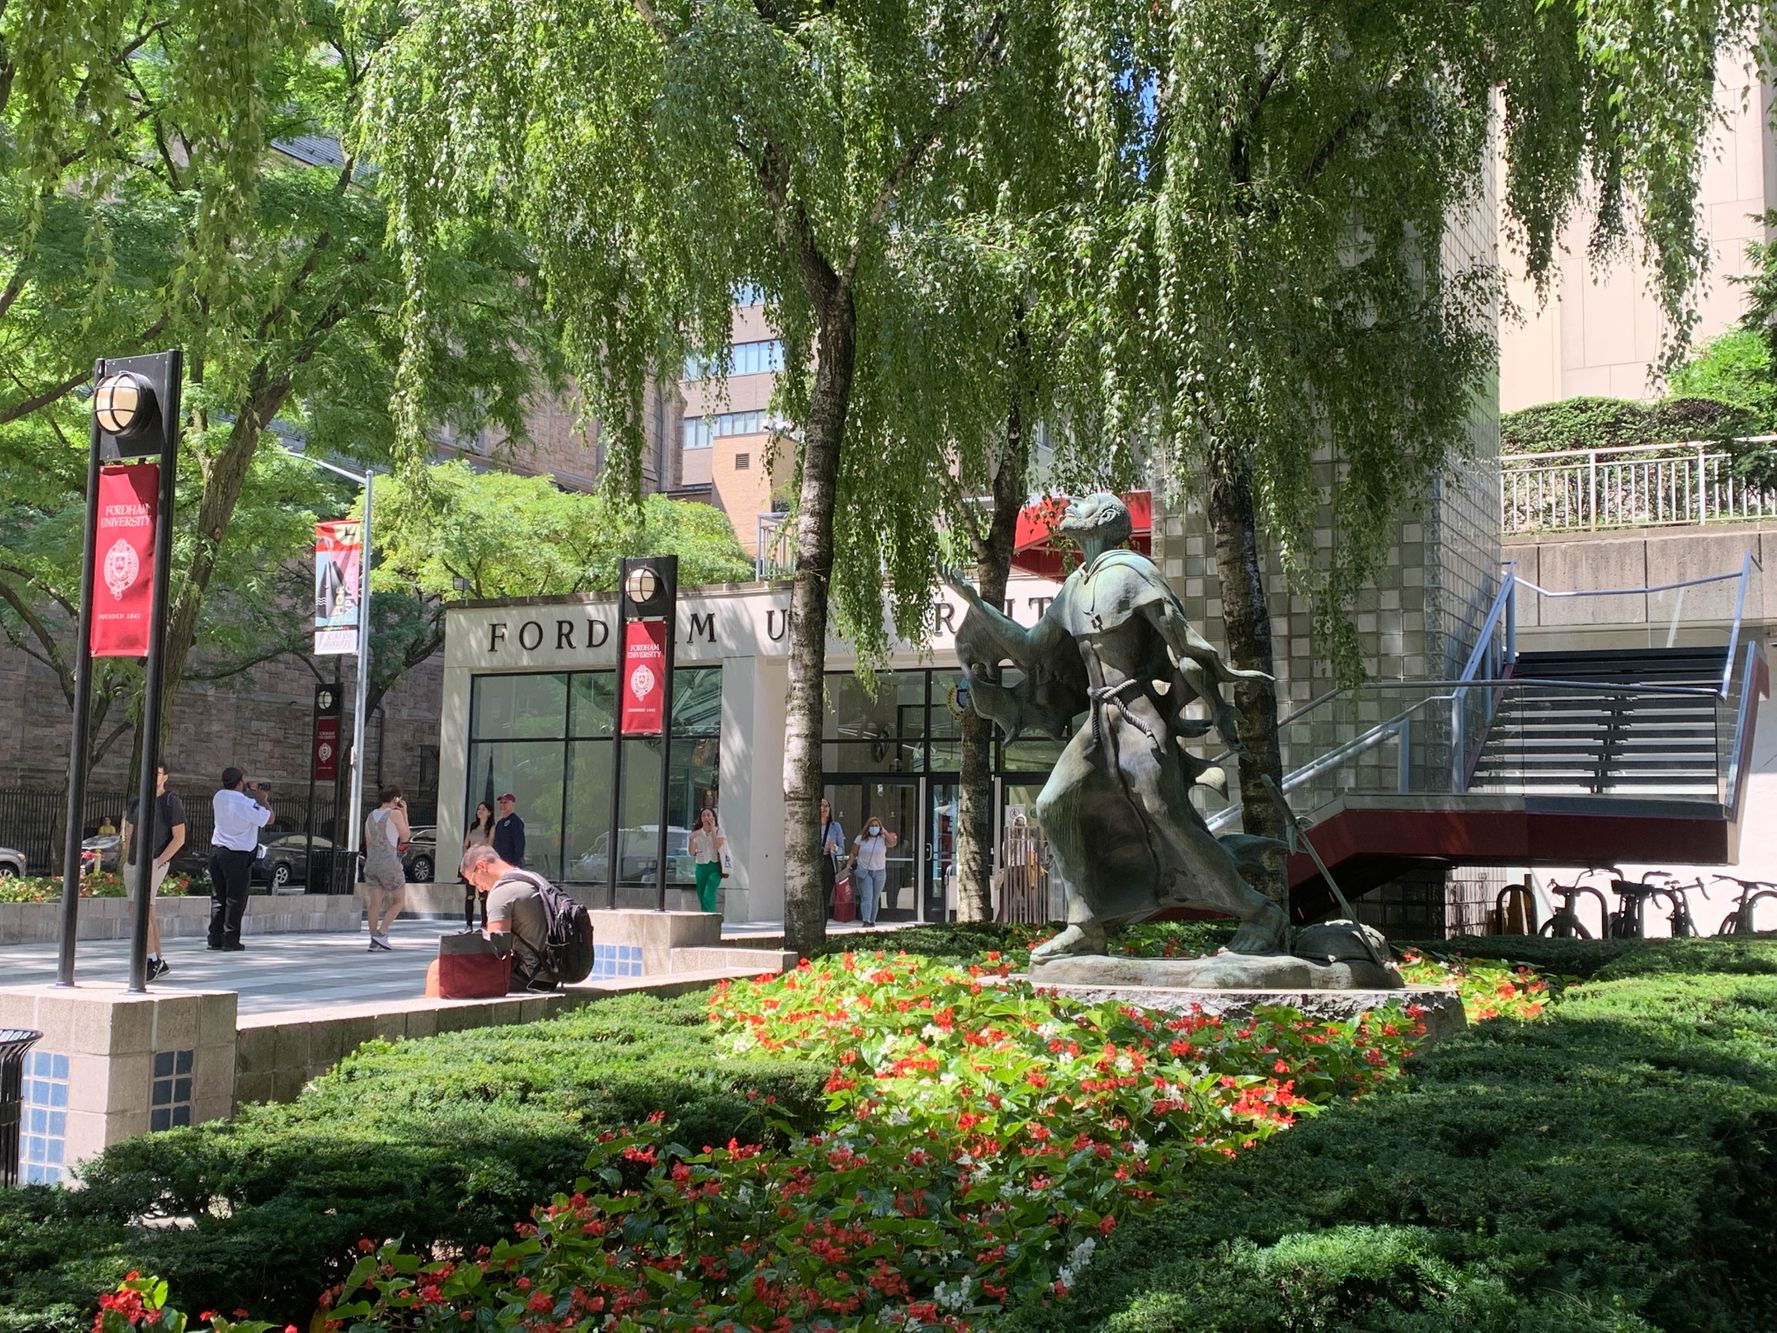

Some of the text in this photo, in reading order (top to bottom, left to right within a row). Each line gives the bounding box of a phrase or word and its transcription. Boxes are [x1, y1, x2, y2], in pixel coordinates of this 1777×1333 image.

[104, 503, 151, 516] FORDHAM
[100, 514, 152, 528] UNIVERSITY
[487, 612, 718, 653] FORDM
[627, 650, 661, 659] UNIVERSITY
